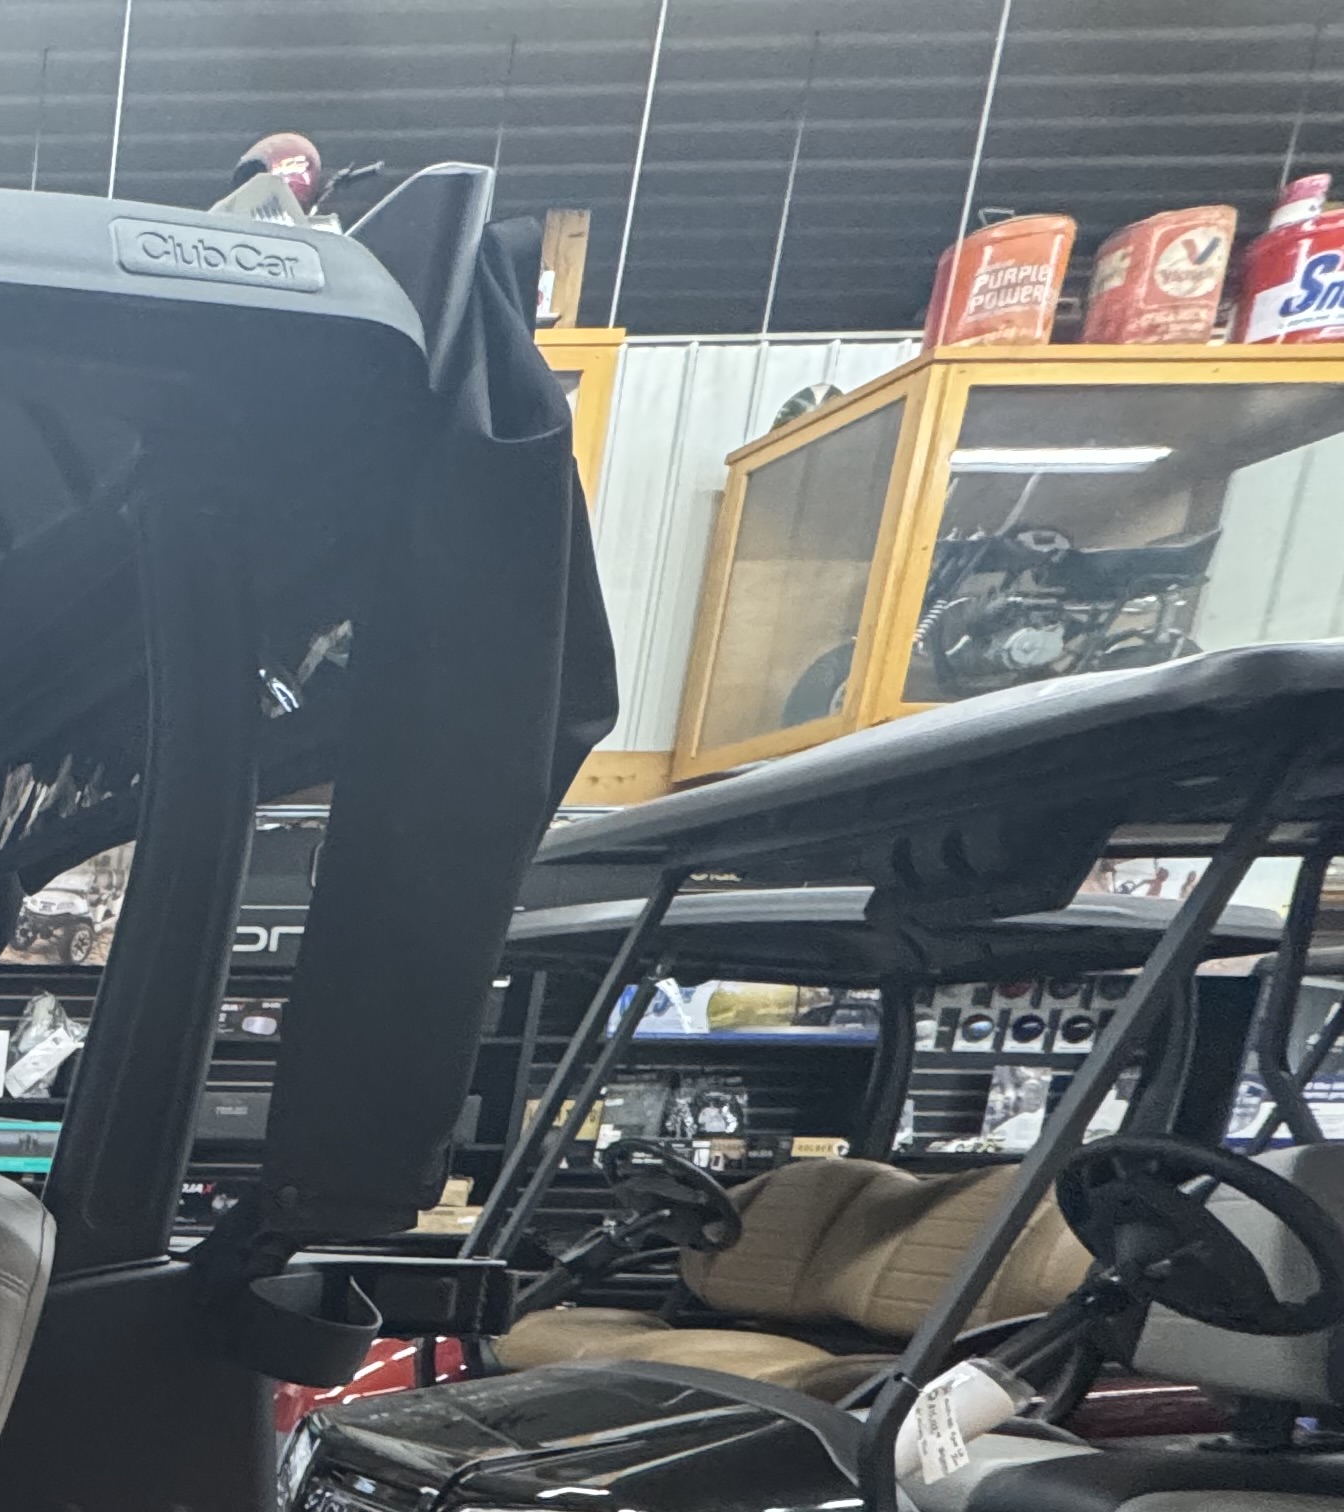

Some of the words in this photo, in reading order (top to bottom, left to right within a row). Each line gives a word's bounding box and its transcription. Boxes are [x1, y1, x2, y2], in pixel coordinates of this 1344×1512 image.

[136, 230, 227, 268] Club
[231, 243, 299, 278] Car
[973, 264, 1053, 296] PURPLE
[968, 283, 1048, 314] POWER
